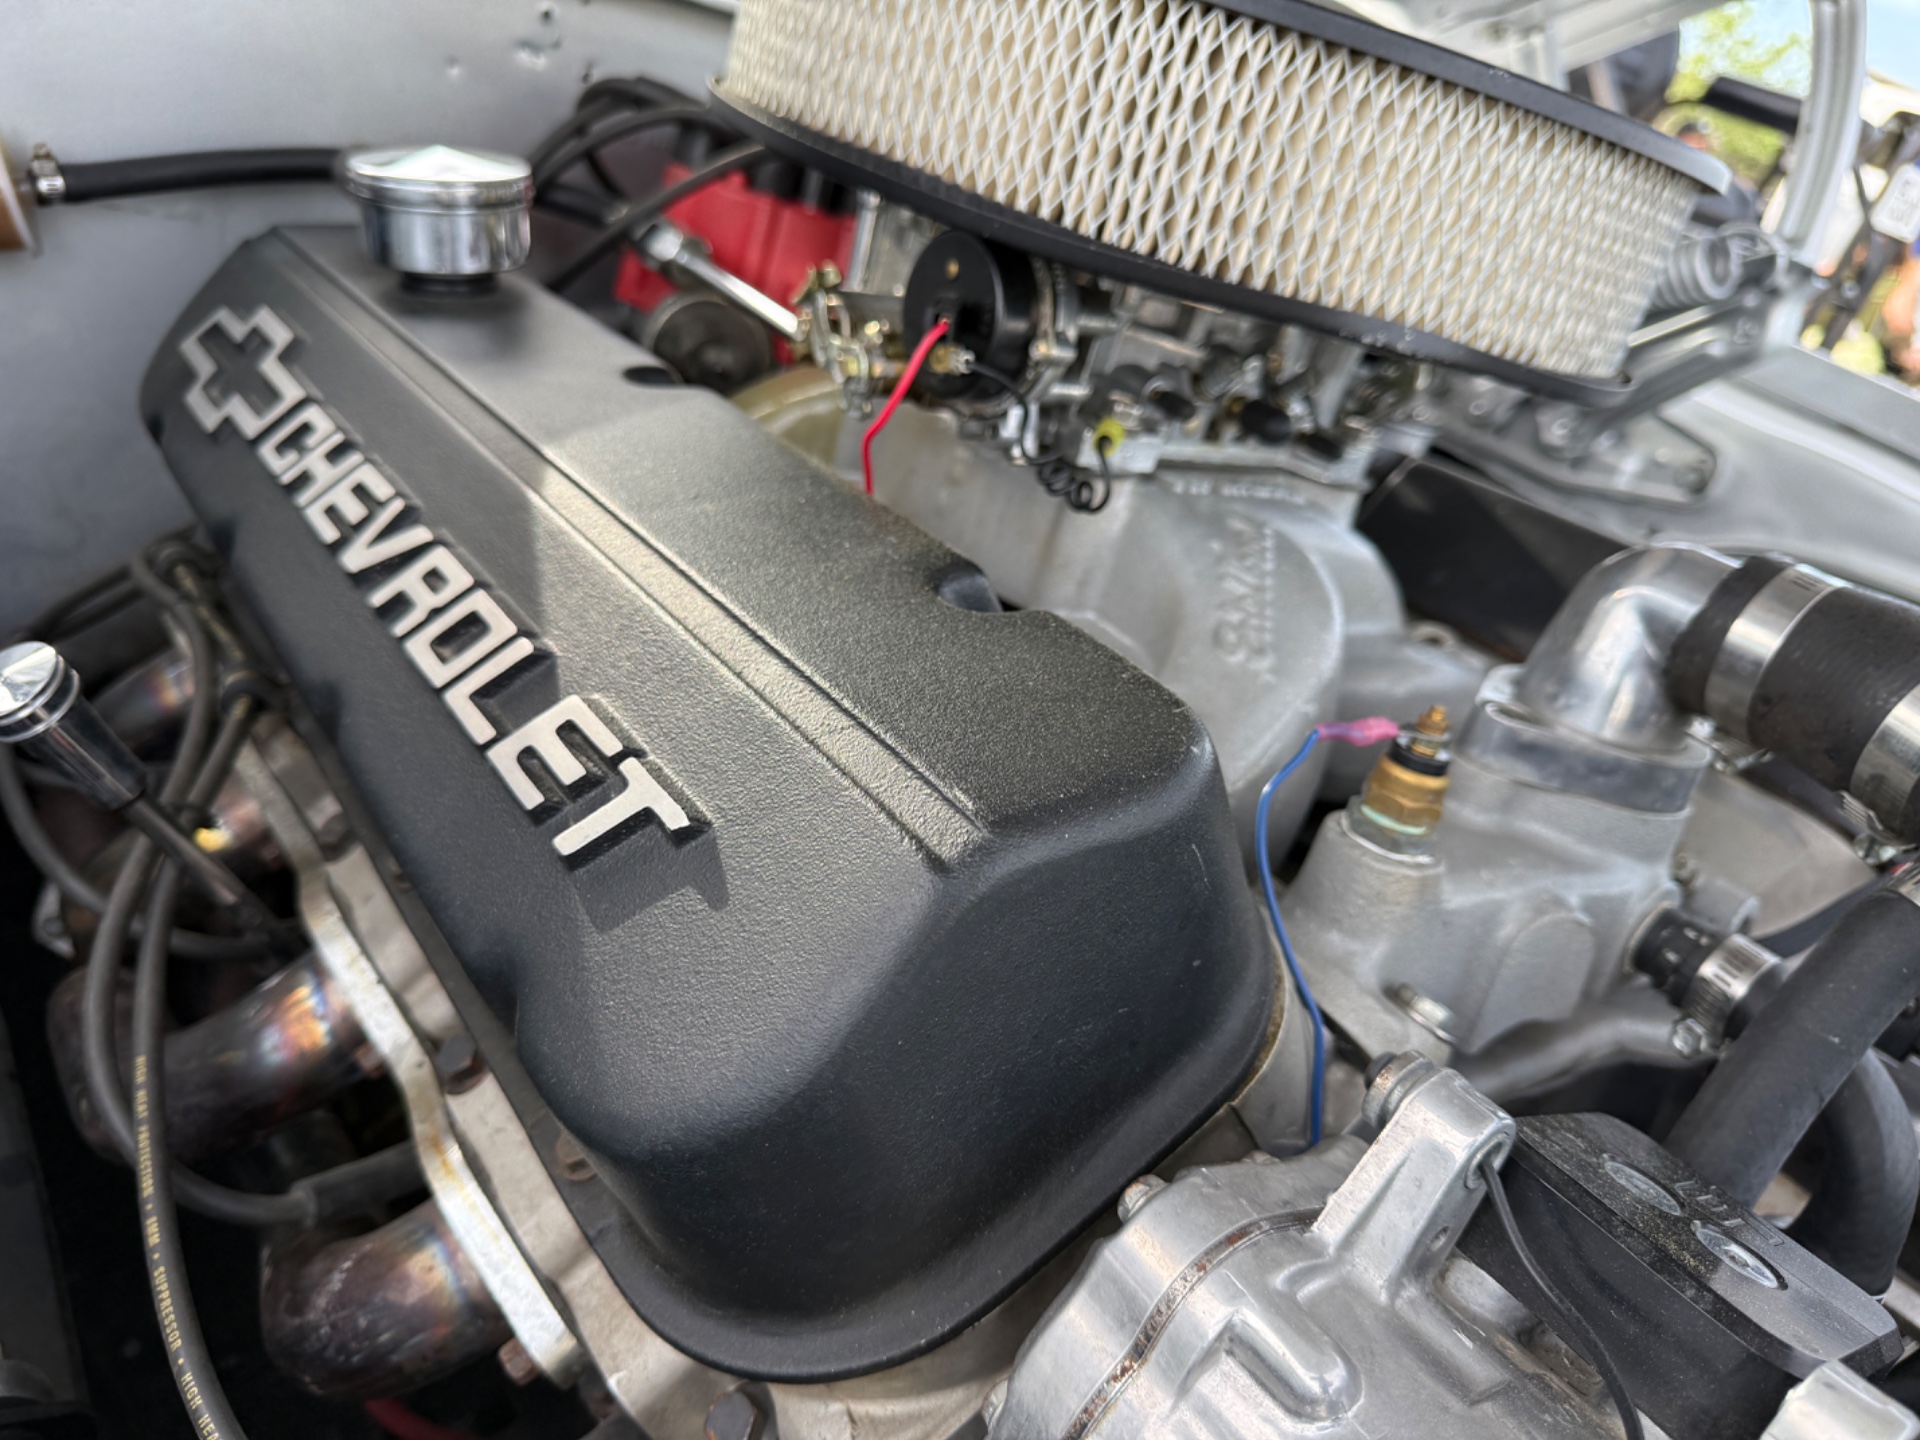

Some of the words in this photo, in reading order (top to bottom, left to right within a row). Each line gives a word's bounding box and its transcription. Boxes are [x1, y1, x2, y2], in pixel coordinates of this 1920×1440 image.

[256, 401, 692, 857] CHEVROLET
[153, 1265, 183, 1352] SUPPRESSOR
[181, 1371, 203, 1410] HIGH
